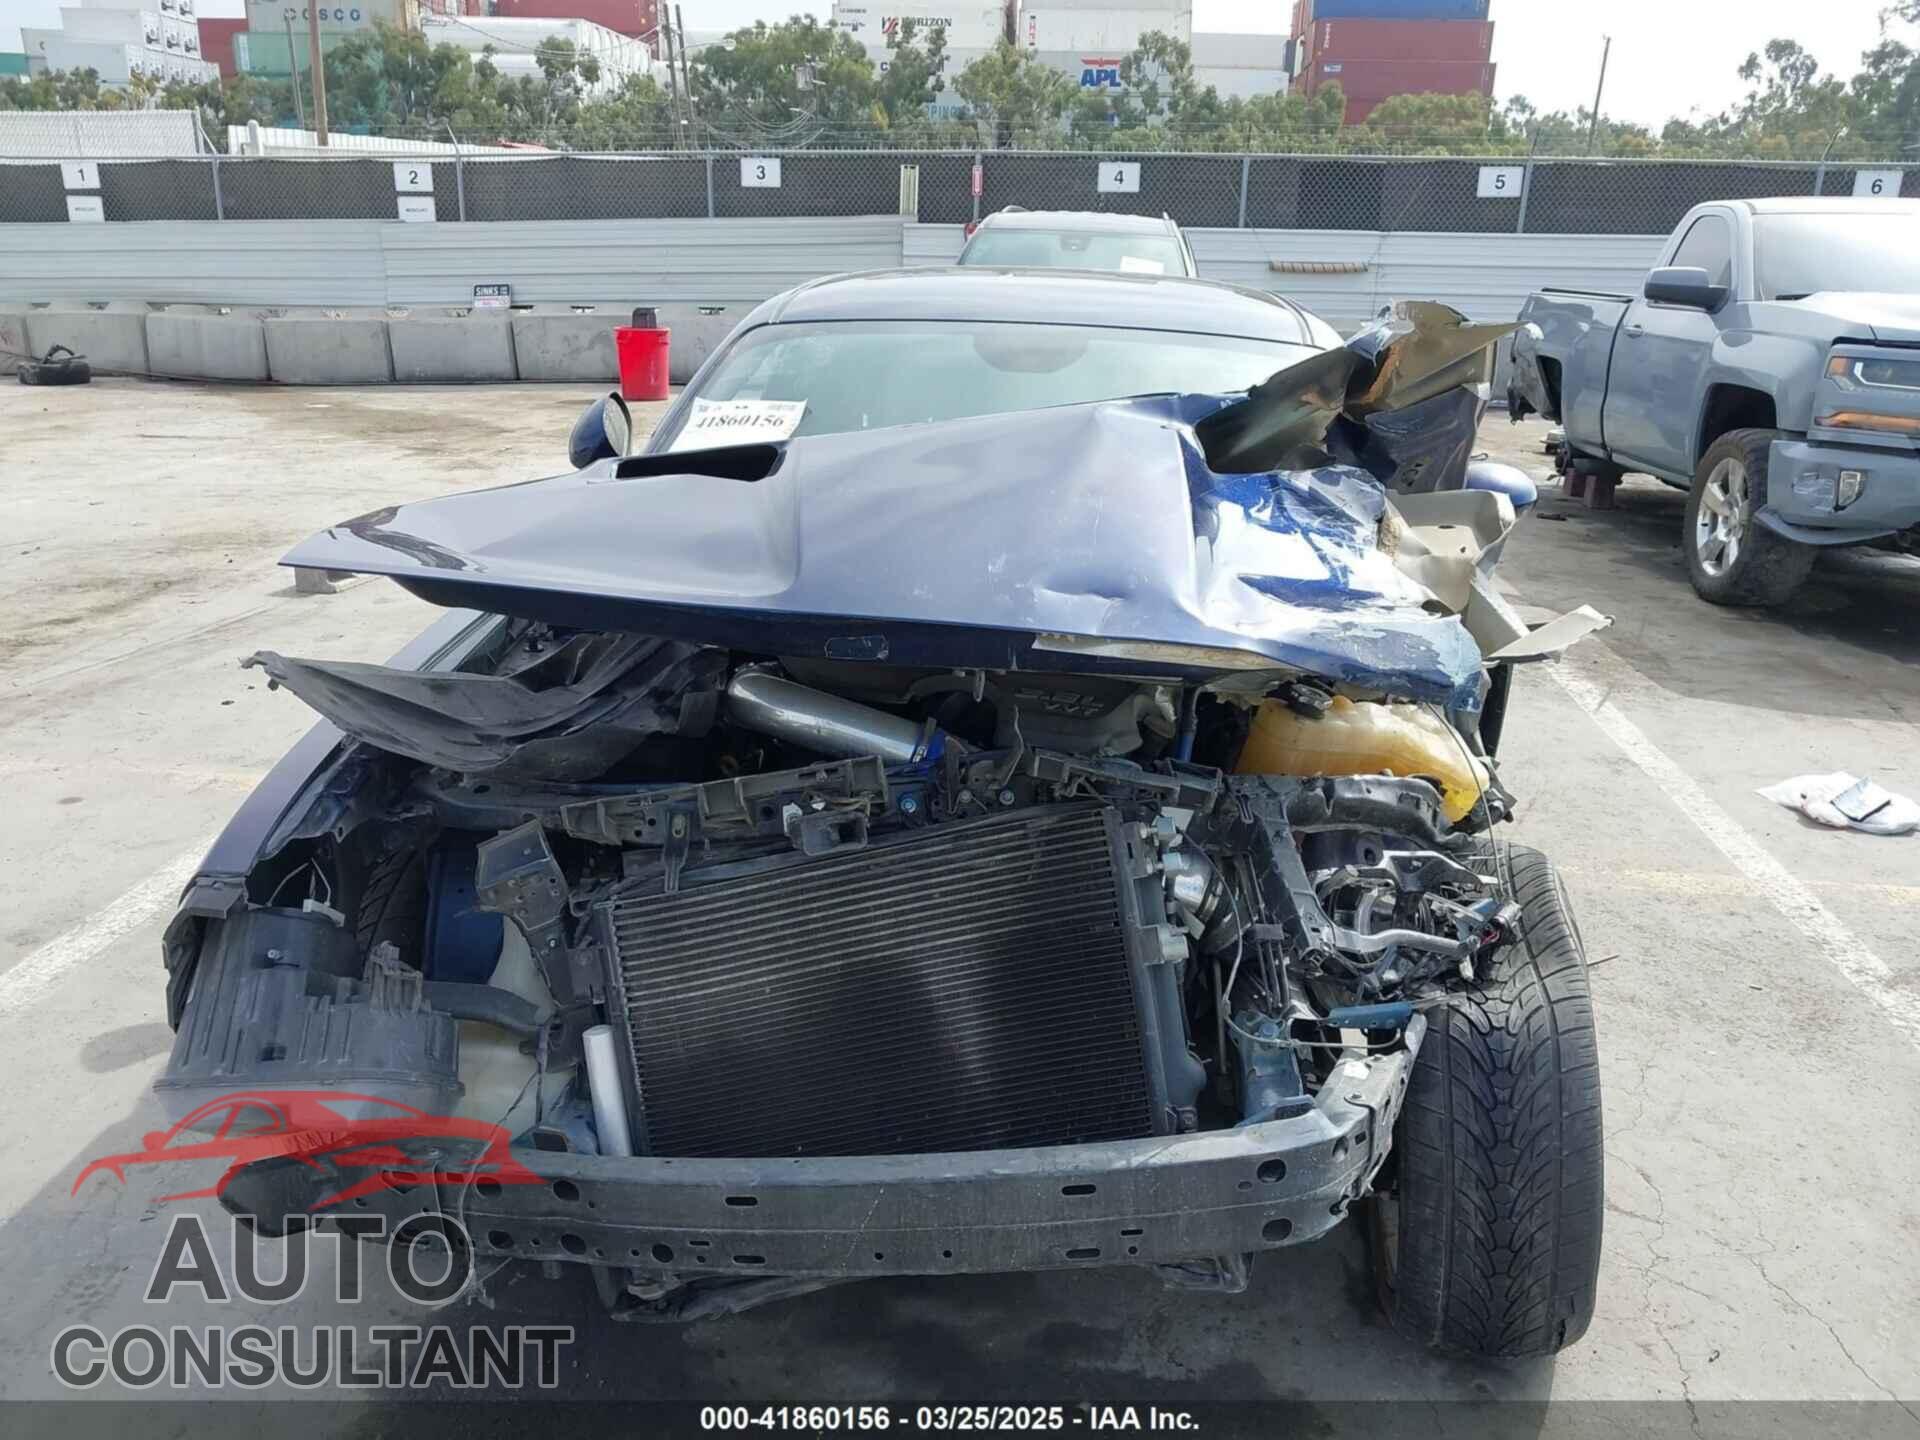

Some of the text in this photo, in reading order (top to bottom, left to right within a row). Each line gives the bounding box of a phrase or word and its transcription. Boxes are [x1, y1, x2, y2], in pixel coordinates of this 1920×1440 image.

[1080, 69, 1121, 87] APL
[77, 169, 85, 181] 1
[408, 169, 419, 184] 2
[756, 165, 766, 181] 3
[1113, 170, 1124, 185] 4
[1494, 175, 1506, 191] 5
[1871, 178, 1884, 195] 6
